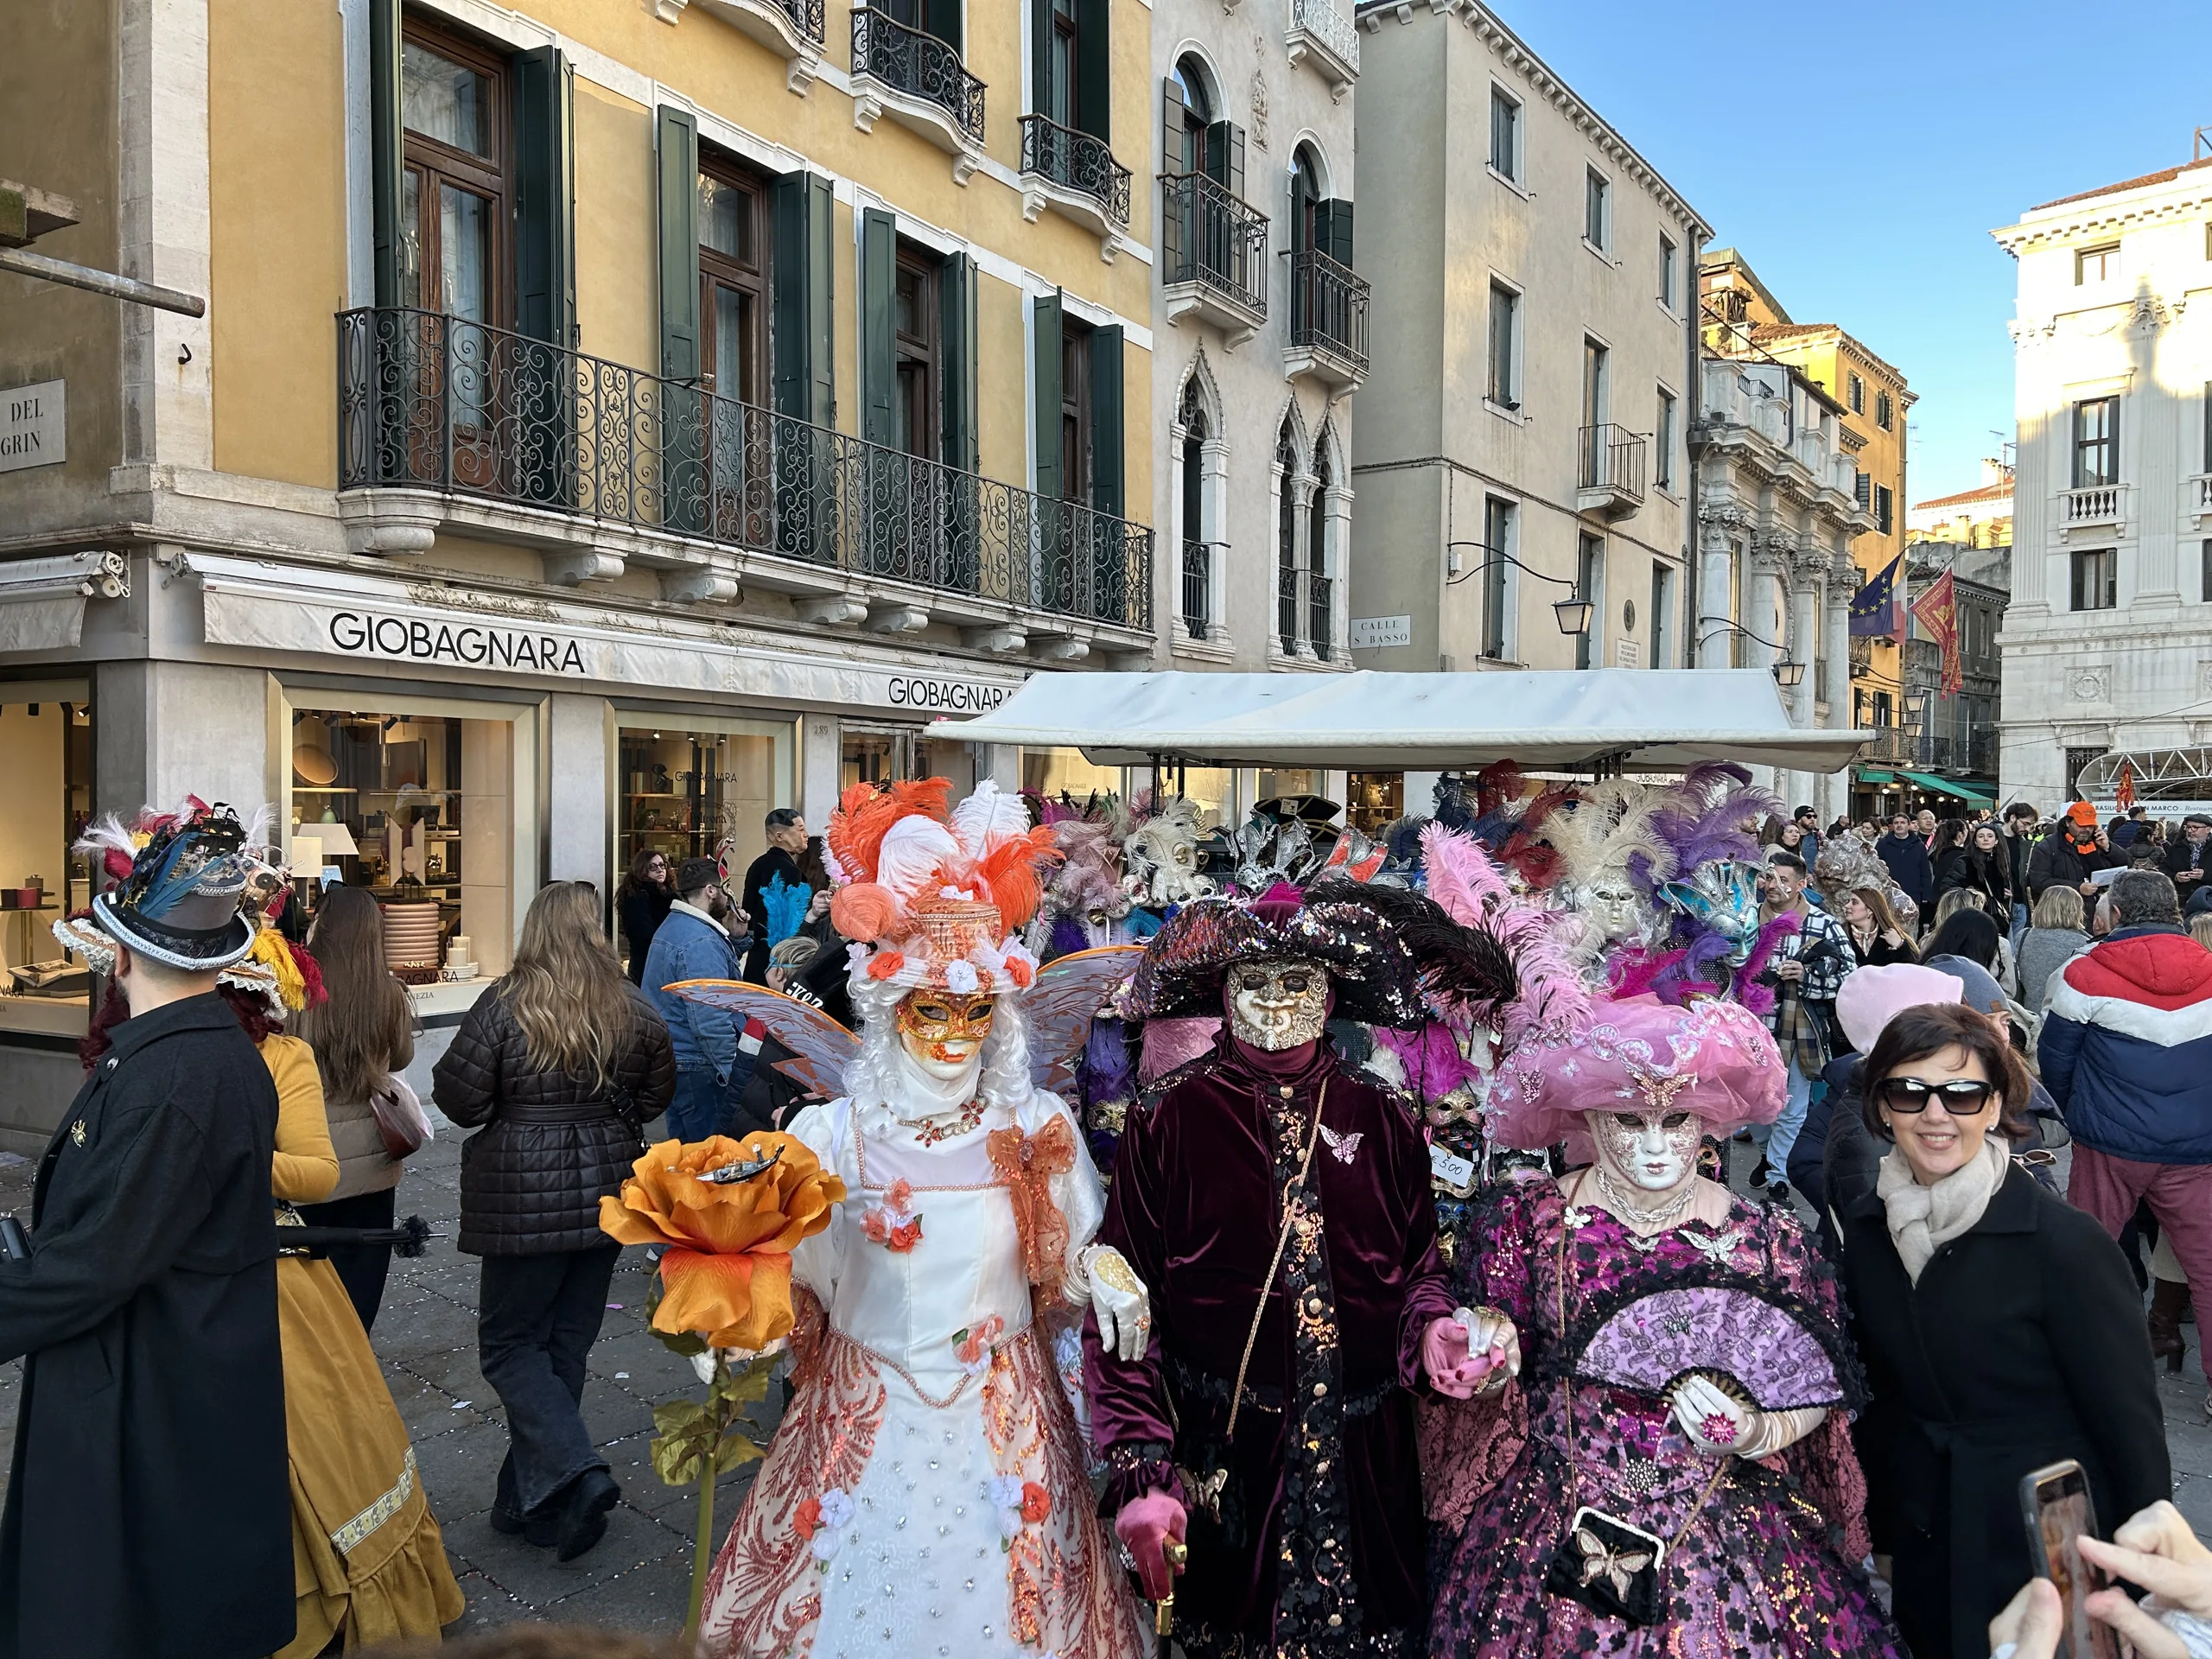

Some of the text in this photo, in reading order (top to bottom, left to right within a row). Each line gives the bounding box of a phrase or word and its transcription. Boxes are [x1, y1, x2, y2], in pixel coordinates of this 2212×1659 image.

[11, 398, 44, 422] DEL
[0, 430, 41, 455] GRIN
[1361, 620, 1399, 631] CALLE
[329, 612, 586, 673] GIOBAGNARA
[1354, 633, 1408, 645] S BASSO
[675, 772, 738, 783] GIOBAGNARA
